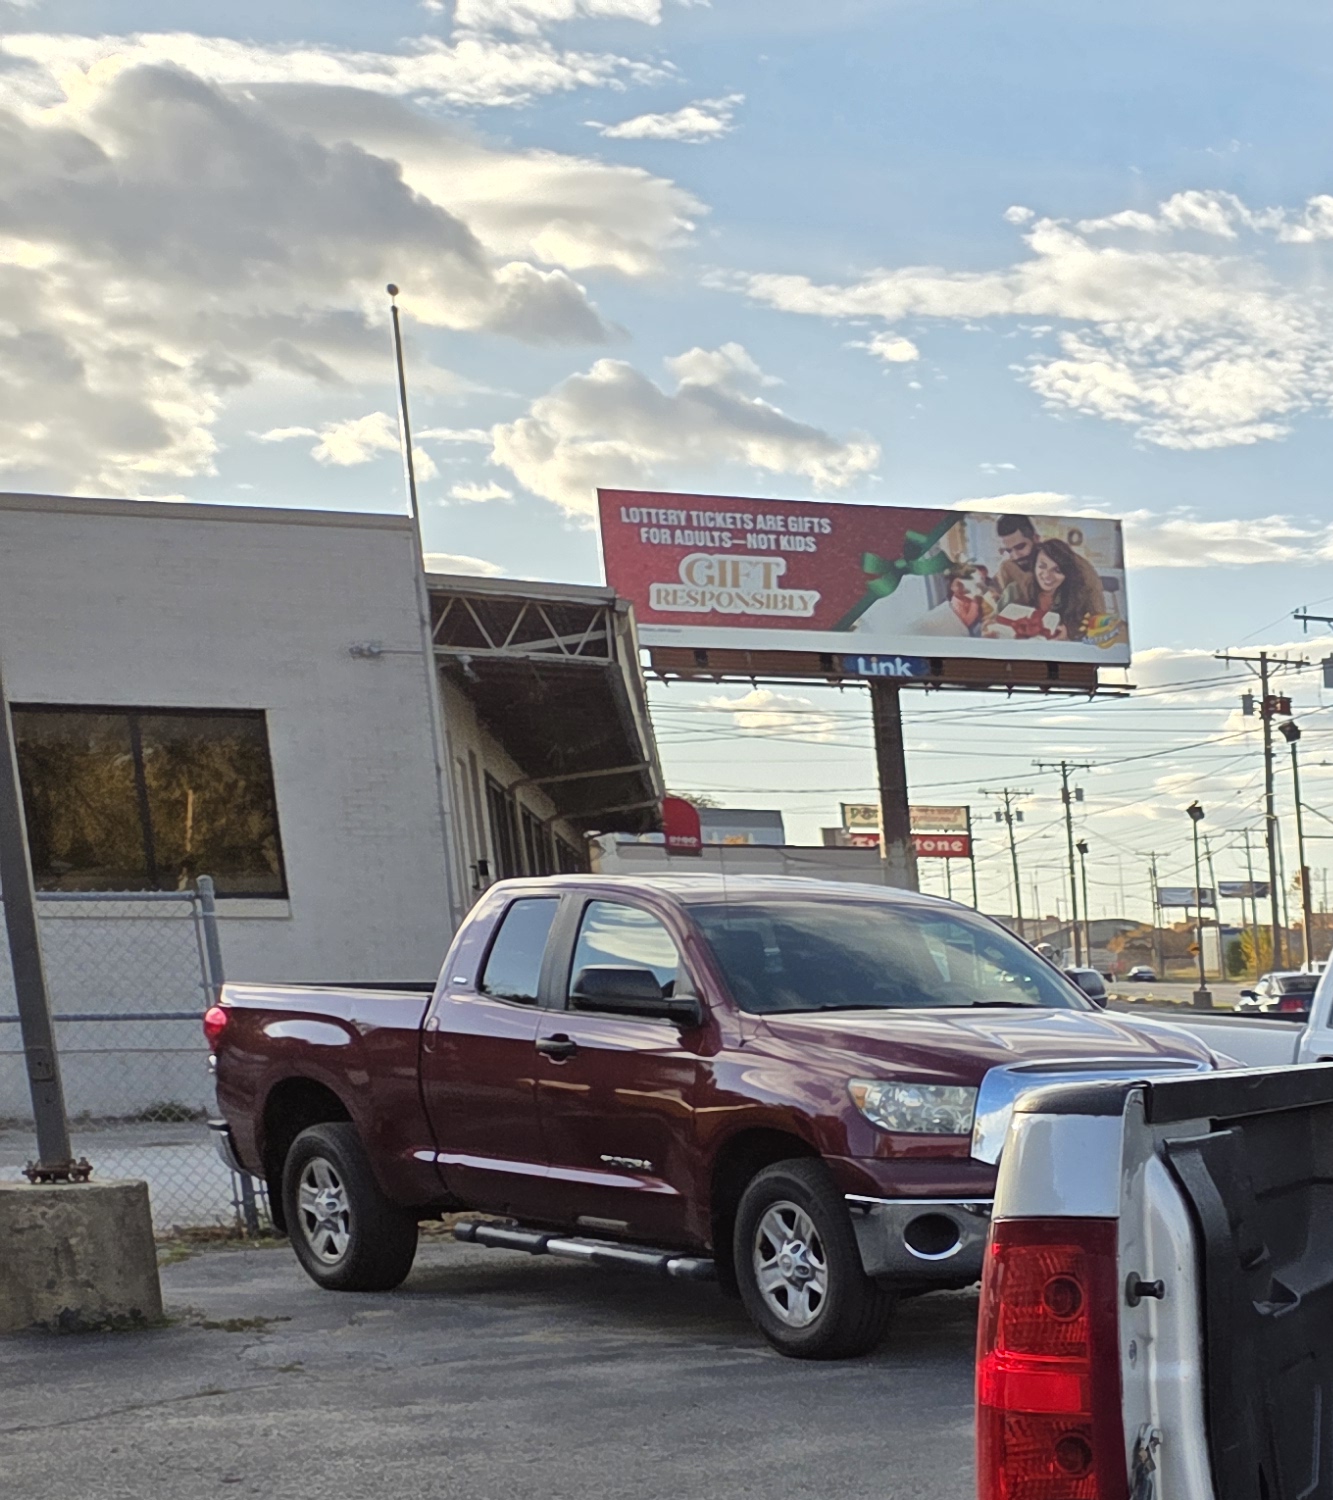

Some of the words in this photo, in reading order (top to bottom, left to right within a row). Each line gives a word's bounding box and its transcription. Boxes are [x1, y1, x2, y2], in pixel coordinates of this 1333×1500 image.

[620, 506, 687, 526] LOTTERY
[689, 510, 754, 530] TICKETS
[756, 514, 787, 532] ARE
[788, 516, 832, 534] GIFTS
[640, 527, 672, 545] FOR
[779, 535, 817, 553] KIDS
[684, 557, 780, 590] GIFT
[655, 588, 817, 612] RESPONSIBLY
[857, 656, 913, 677] Link
